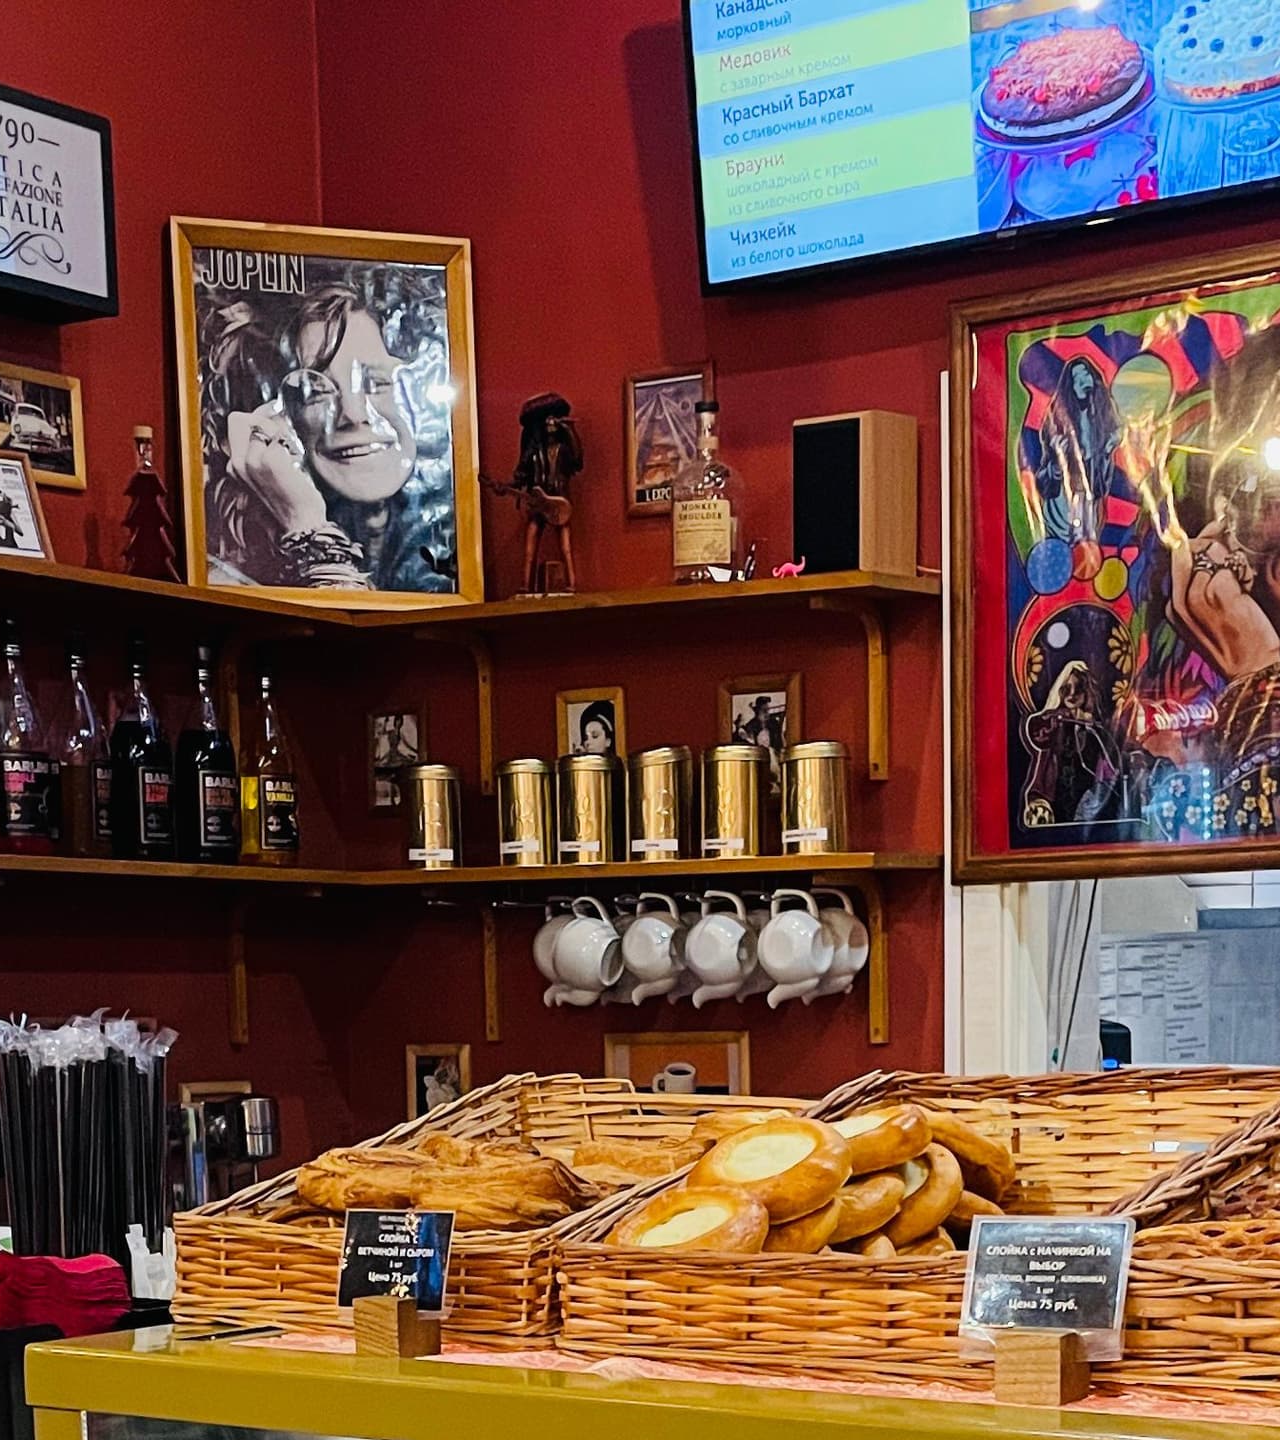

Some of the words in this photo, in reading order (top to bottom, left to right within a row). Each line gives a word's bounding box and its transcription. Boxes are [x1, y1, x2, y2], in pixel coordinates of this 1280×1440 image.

[717, 12, 792, 41] морковный
[719, 43, 792, 73] Медовик
[798, 53, 852, 75] кремом
[722, 94, 795, 126] Красный
[799, 82, 855, 109] Бархат
[723, 133, 739, 146] со
[742, 115, 817, 142] сливочным
[821, 103, 874, 127] кремом
[726, 153, 785, 179] Брауни
[727, 171, 809, 198] шоколадный
[825, 155, 879, 178] кремом
[746, 189, 823, 214] сливочного
[730, 222, 797, 247] Чизкейк
[731, 256, 745, 269] из
[749, 246, 794, 264] белого
[798, 232, 864, 256] шоколада
[201, 249, 305, 295] JOPLIN
[681, 503, 717, 511] MONKEY
[986, 1243, 1028, 1257] СЛОЙКА
[1037, 1244, 1094, 1257] НАЧИНКОЙ
[1097, 1246, 1111, 1256] НА
[1008, 1299, 1037, 1310] Цена
[1040, 1299, 1052, 1310] 75
[1055, 1299, 1078, 1312] руб.
